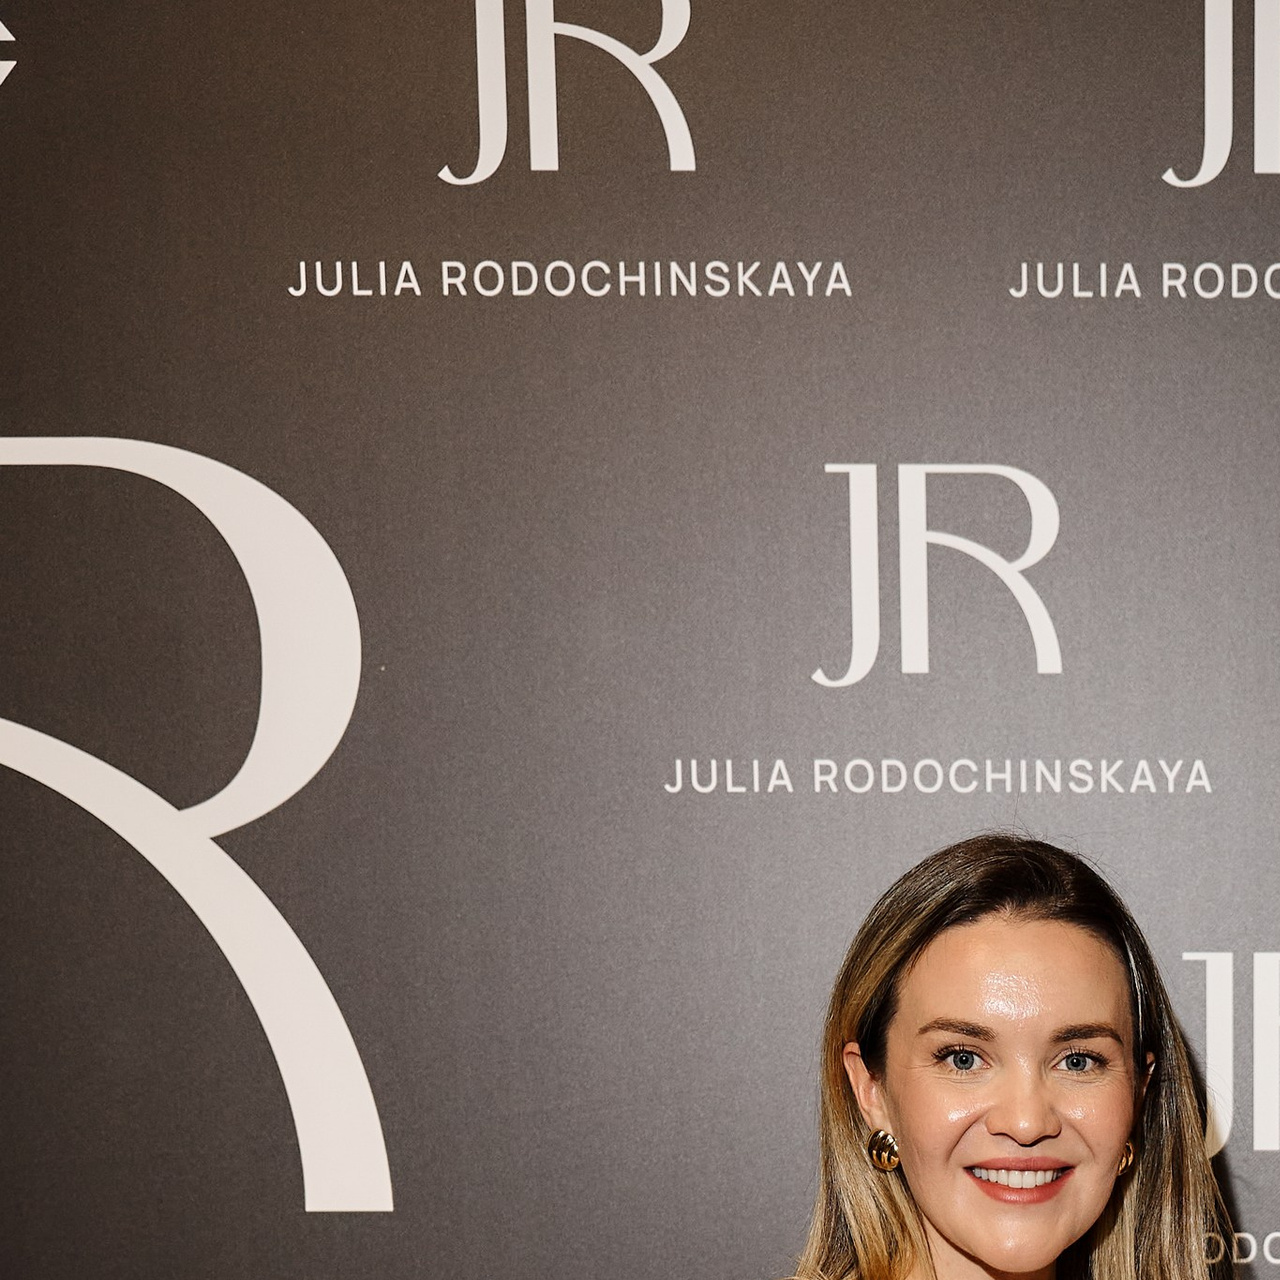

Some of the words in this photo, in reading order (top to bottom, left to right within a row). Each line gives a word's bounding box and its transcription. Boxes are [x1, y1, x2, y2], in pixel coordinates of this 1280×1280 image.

[438, 0, 696, 186] JR
[288, 261, 421, 297] JULIA
[442, 261, 852, 297] RODOCHINSKAYA
[1009, 263, 1141, 298] JULIA
[811, 463, 1062, 688] JR
[665, 759, 793, 793] JULIA
[814, 759, 1211, 794] RODOCHINSKAYA
